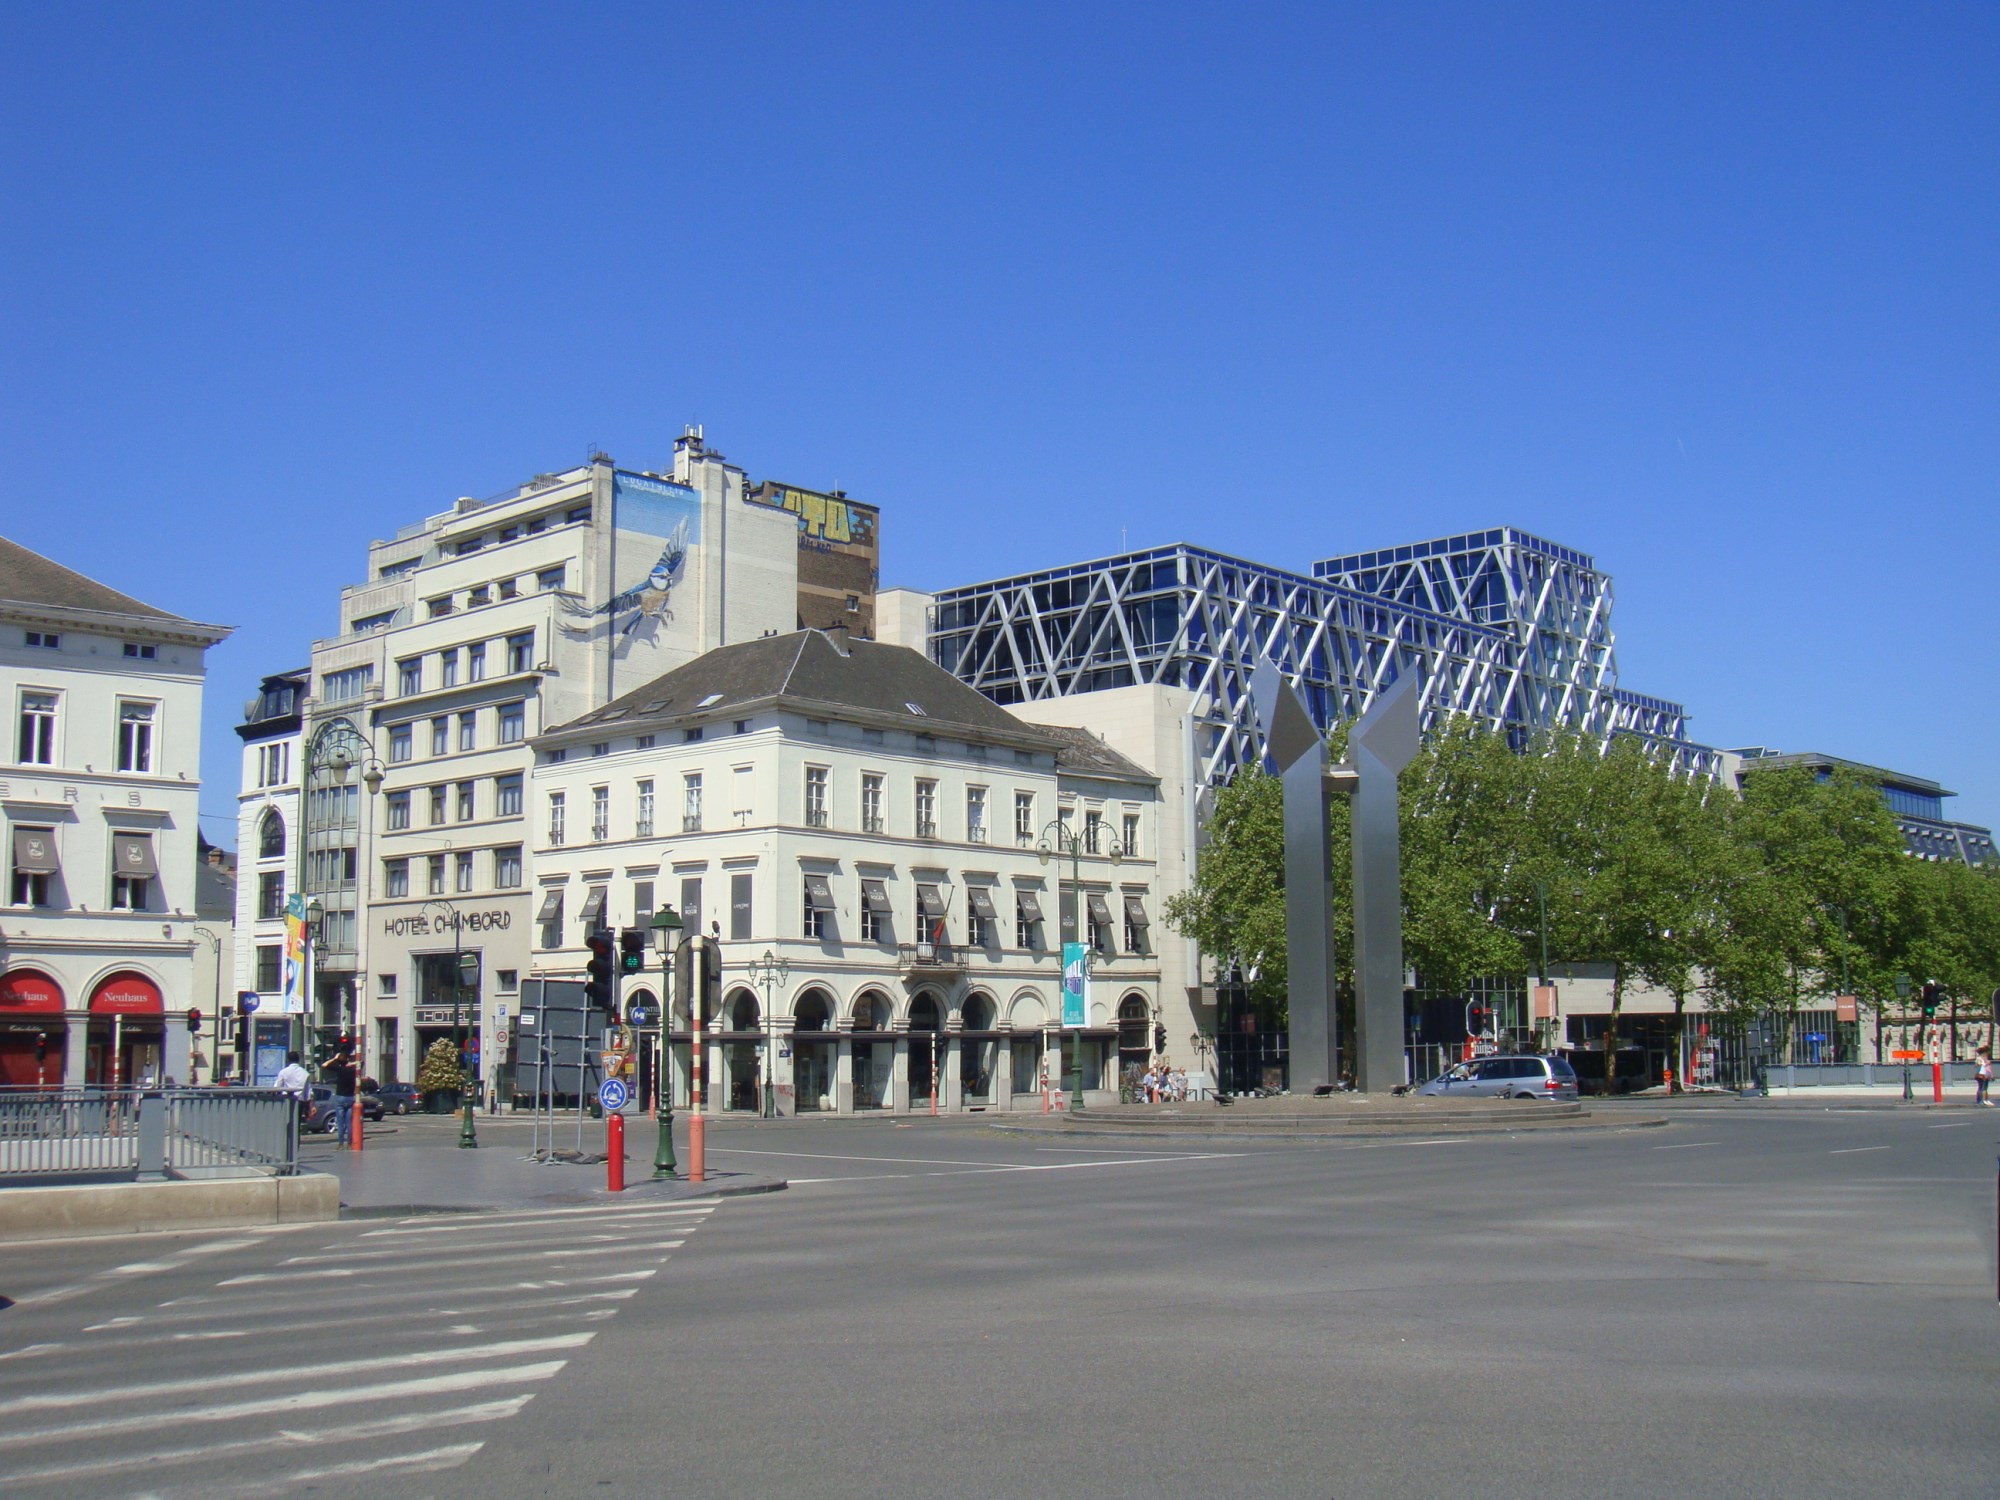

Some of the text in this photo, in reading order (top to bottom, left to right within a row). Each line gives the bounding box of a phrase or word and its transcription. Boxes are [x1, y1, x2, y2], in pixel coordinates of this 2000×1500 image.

[384, 910, 511, 936] HOTEL CHAMBORD
[3, 990, 49, 1002] Neuhaus
[104, 991, 148, 1002] Neuhaus
